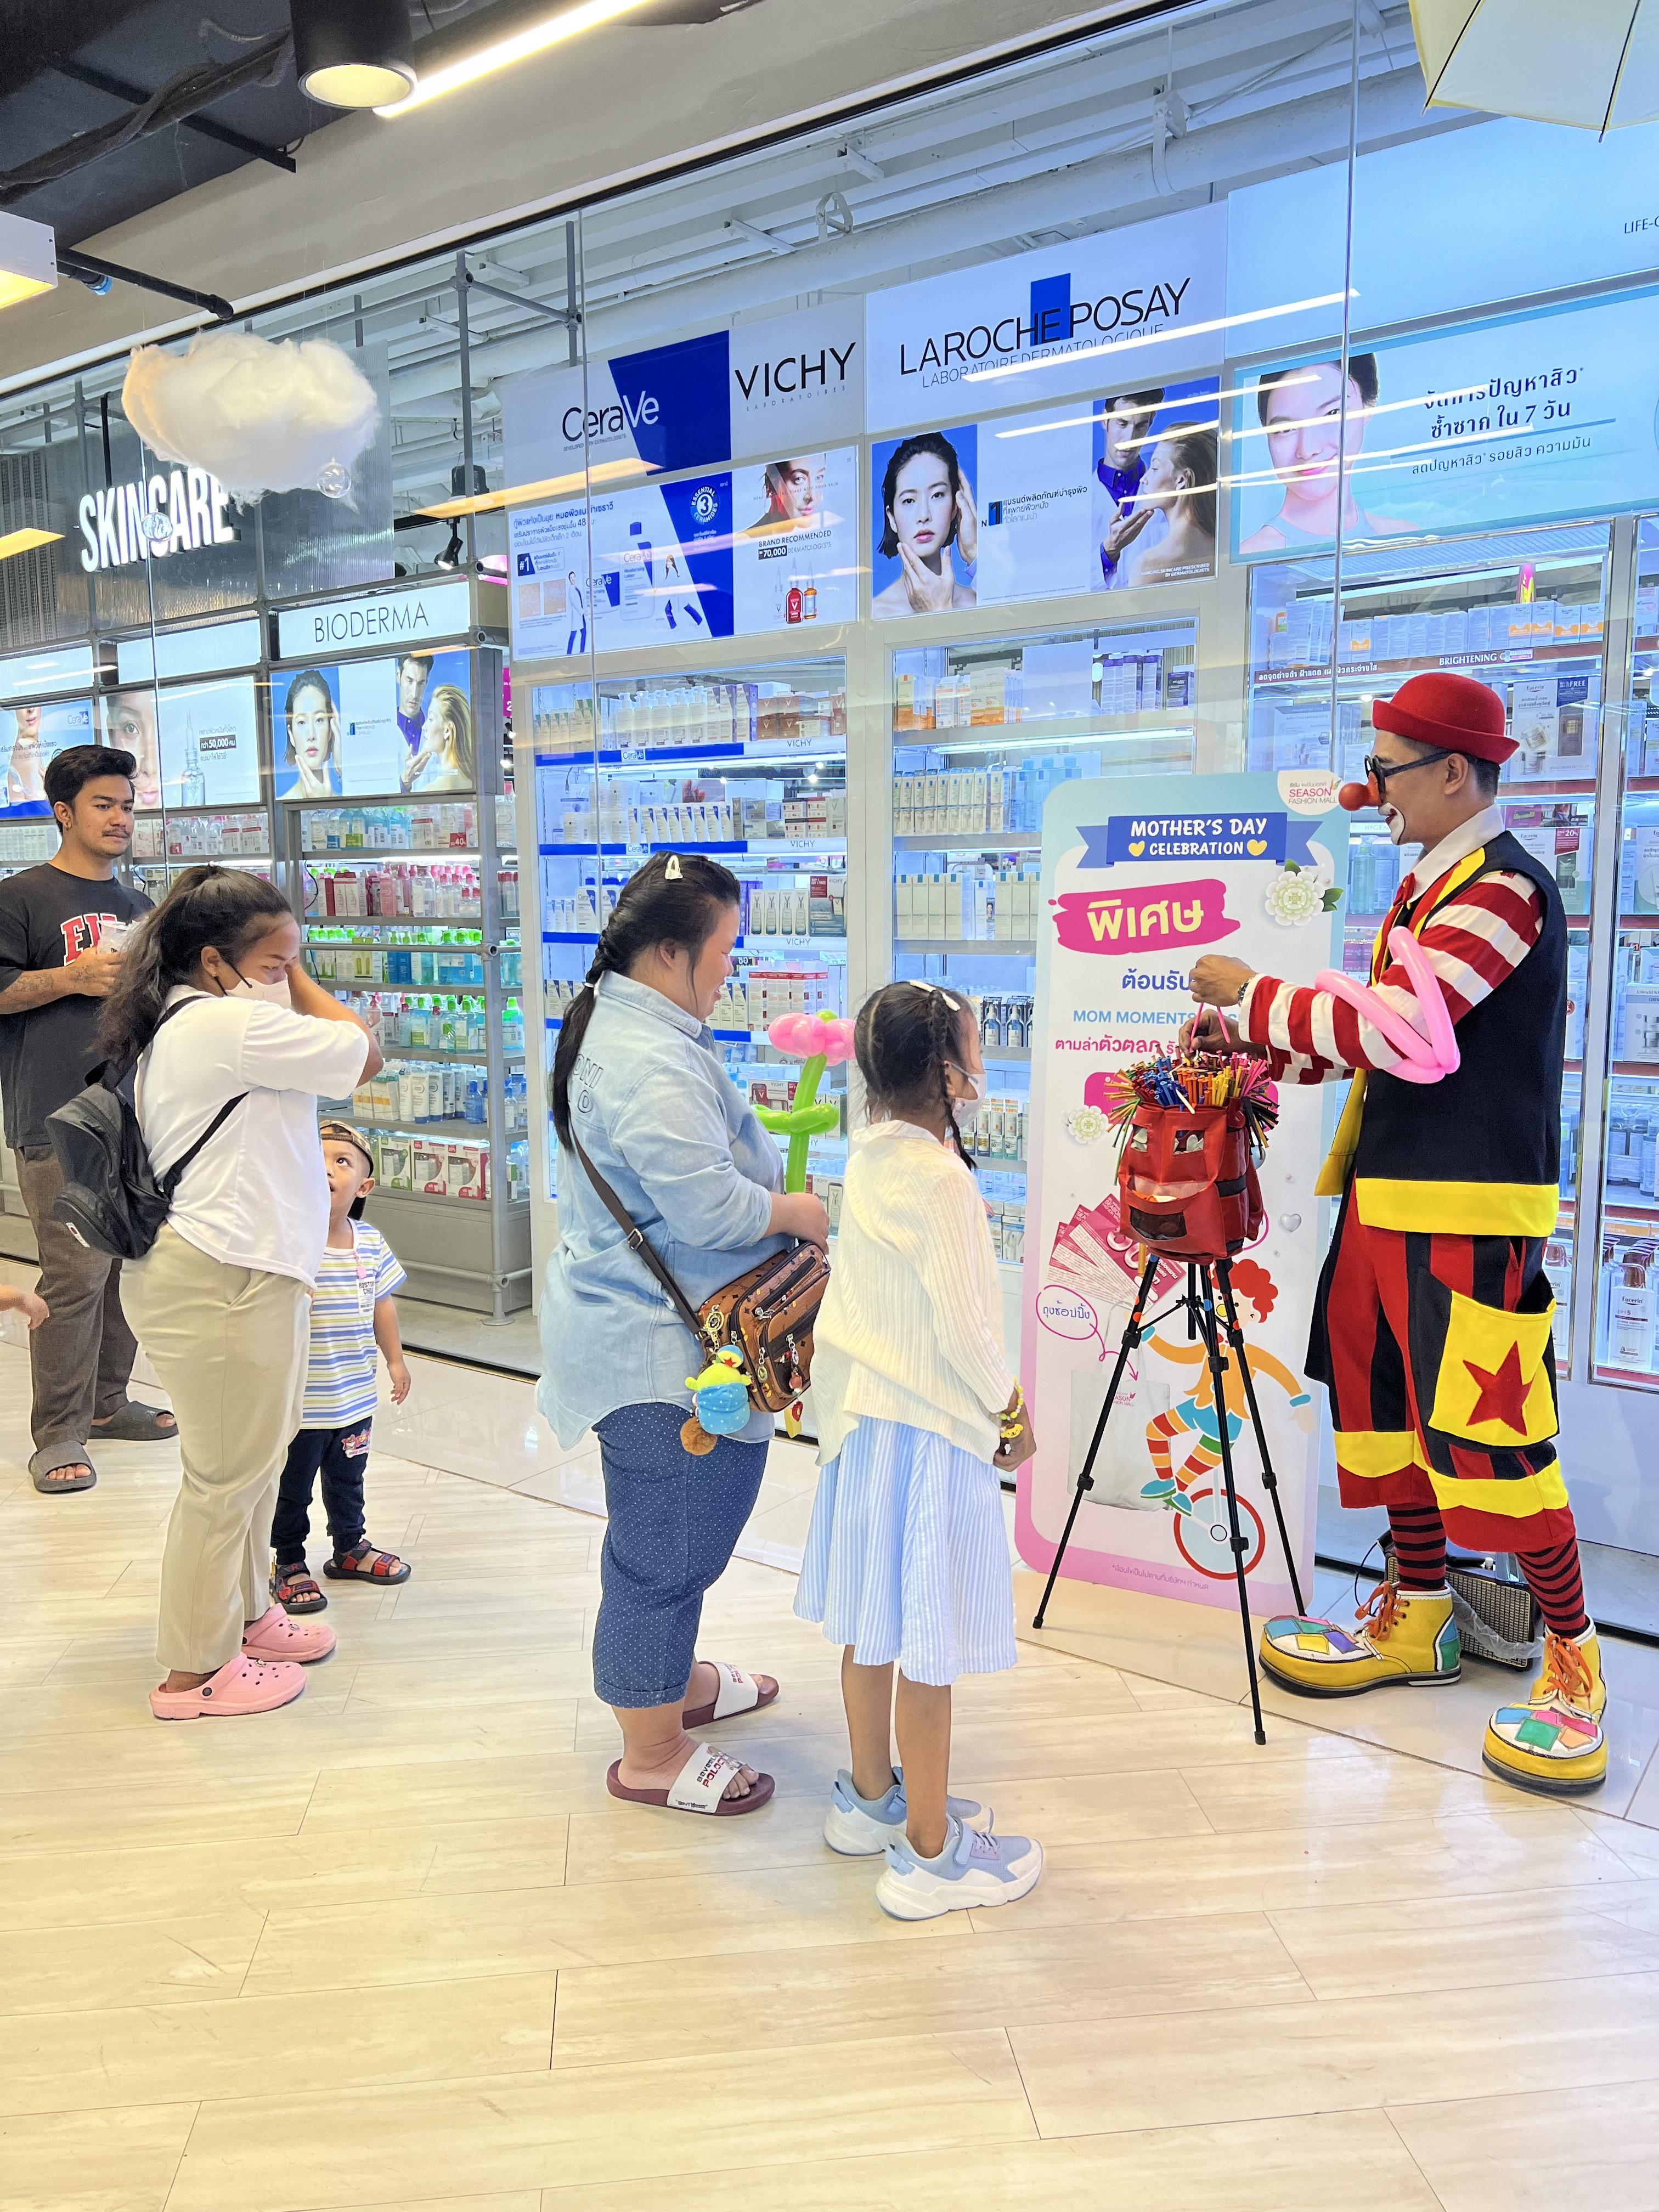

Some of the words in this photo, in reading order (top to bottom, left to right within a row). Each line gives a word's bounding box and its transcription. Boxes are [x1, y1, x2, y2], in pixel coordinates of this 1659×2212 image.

[735, 342, 856, 400] VICHY
[747, 385, 845, 411] LABORATOIRES
[562, 390, 659, 442] CeraVe
[1431, 414, 1490, 438] ซ้ำซาก
[1498, 404, 1519, 427] ใน
[1526, 405, 1537, 423] 7
[1543, 400, 1571, 419] วัน
[1489, 446, 1532, 462] รอยสิว
[1537, 436, 1591, 455] ความมัน
[691, 486, 715, 506] ESSENTIAL
[1003, 485, 1088, 506] แบรนด์ผลิตภัณฑ์บำรุงผิว
[693, 502, 718, 523] CERAMIDES
[700, 495, 709, 514] 3
[578, 518, 586, 527] 48
[759, 538, 780, 548] BRAND
[782, 530, 832, 543] RECOMMENDED
[624, 550, 651, 563] CeraVe
[763, 546, 786, 558] 70,000
[787, 541, 832, 554] DERMATOLOGISTS
[519, 556, 529, 572] #1
[314, 601, 429, 643] BIODERMA
[1439, 653, 1497, 666] BRIGHTENING
[67, 712, 89, 725] CeraVe
[208, 737, 229, 749] 50,000
[786, 738, 812, 747] VICHY
[623, 750, 644, 759] CeraVe
[1289, 787, 1332, 798] SEASON
[1131, 818, 1223, 837] MOTHER'S
[1229, 817, 1268, 836] DAY
[627, 844, 649, 853] CeraVe
[790, 840, 815, 848] VICHY
[1149, 841, 1244, 856] CELEBRATION
[1086, 899, 1205, 942] พิเศษ
[1122, 968, 1189, 991] ต้อนรับ
[1073, 1010, 1112, 1023] MOM
[1622, 1296, 1643, 1304] Eucerin
[1042, 1300, 1091, 1319] ถุงช้อปปิ้ง
